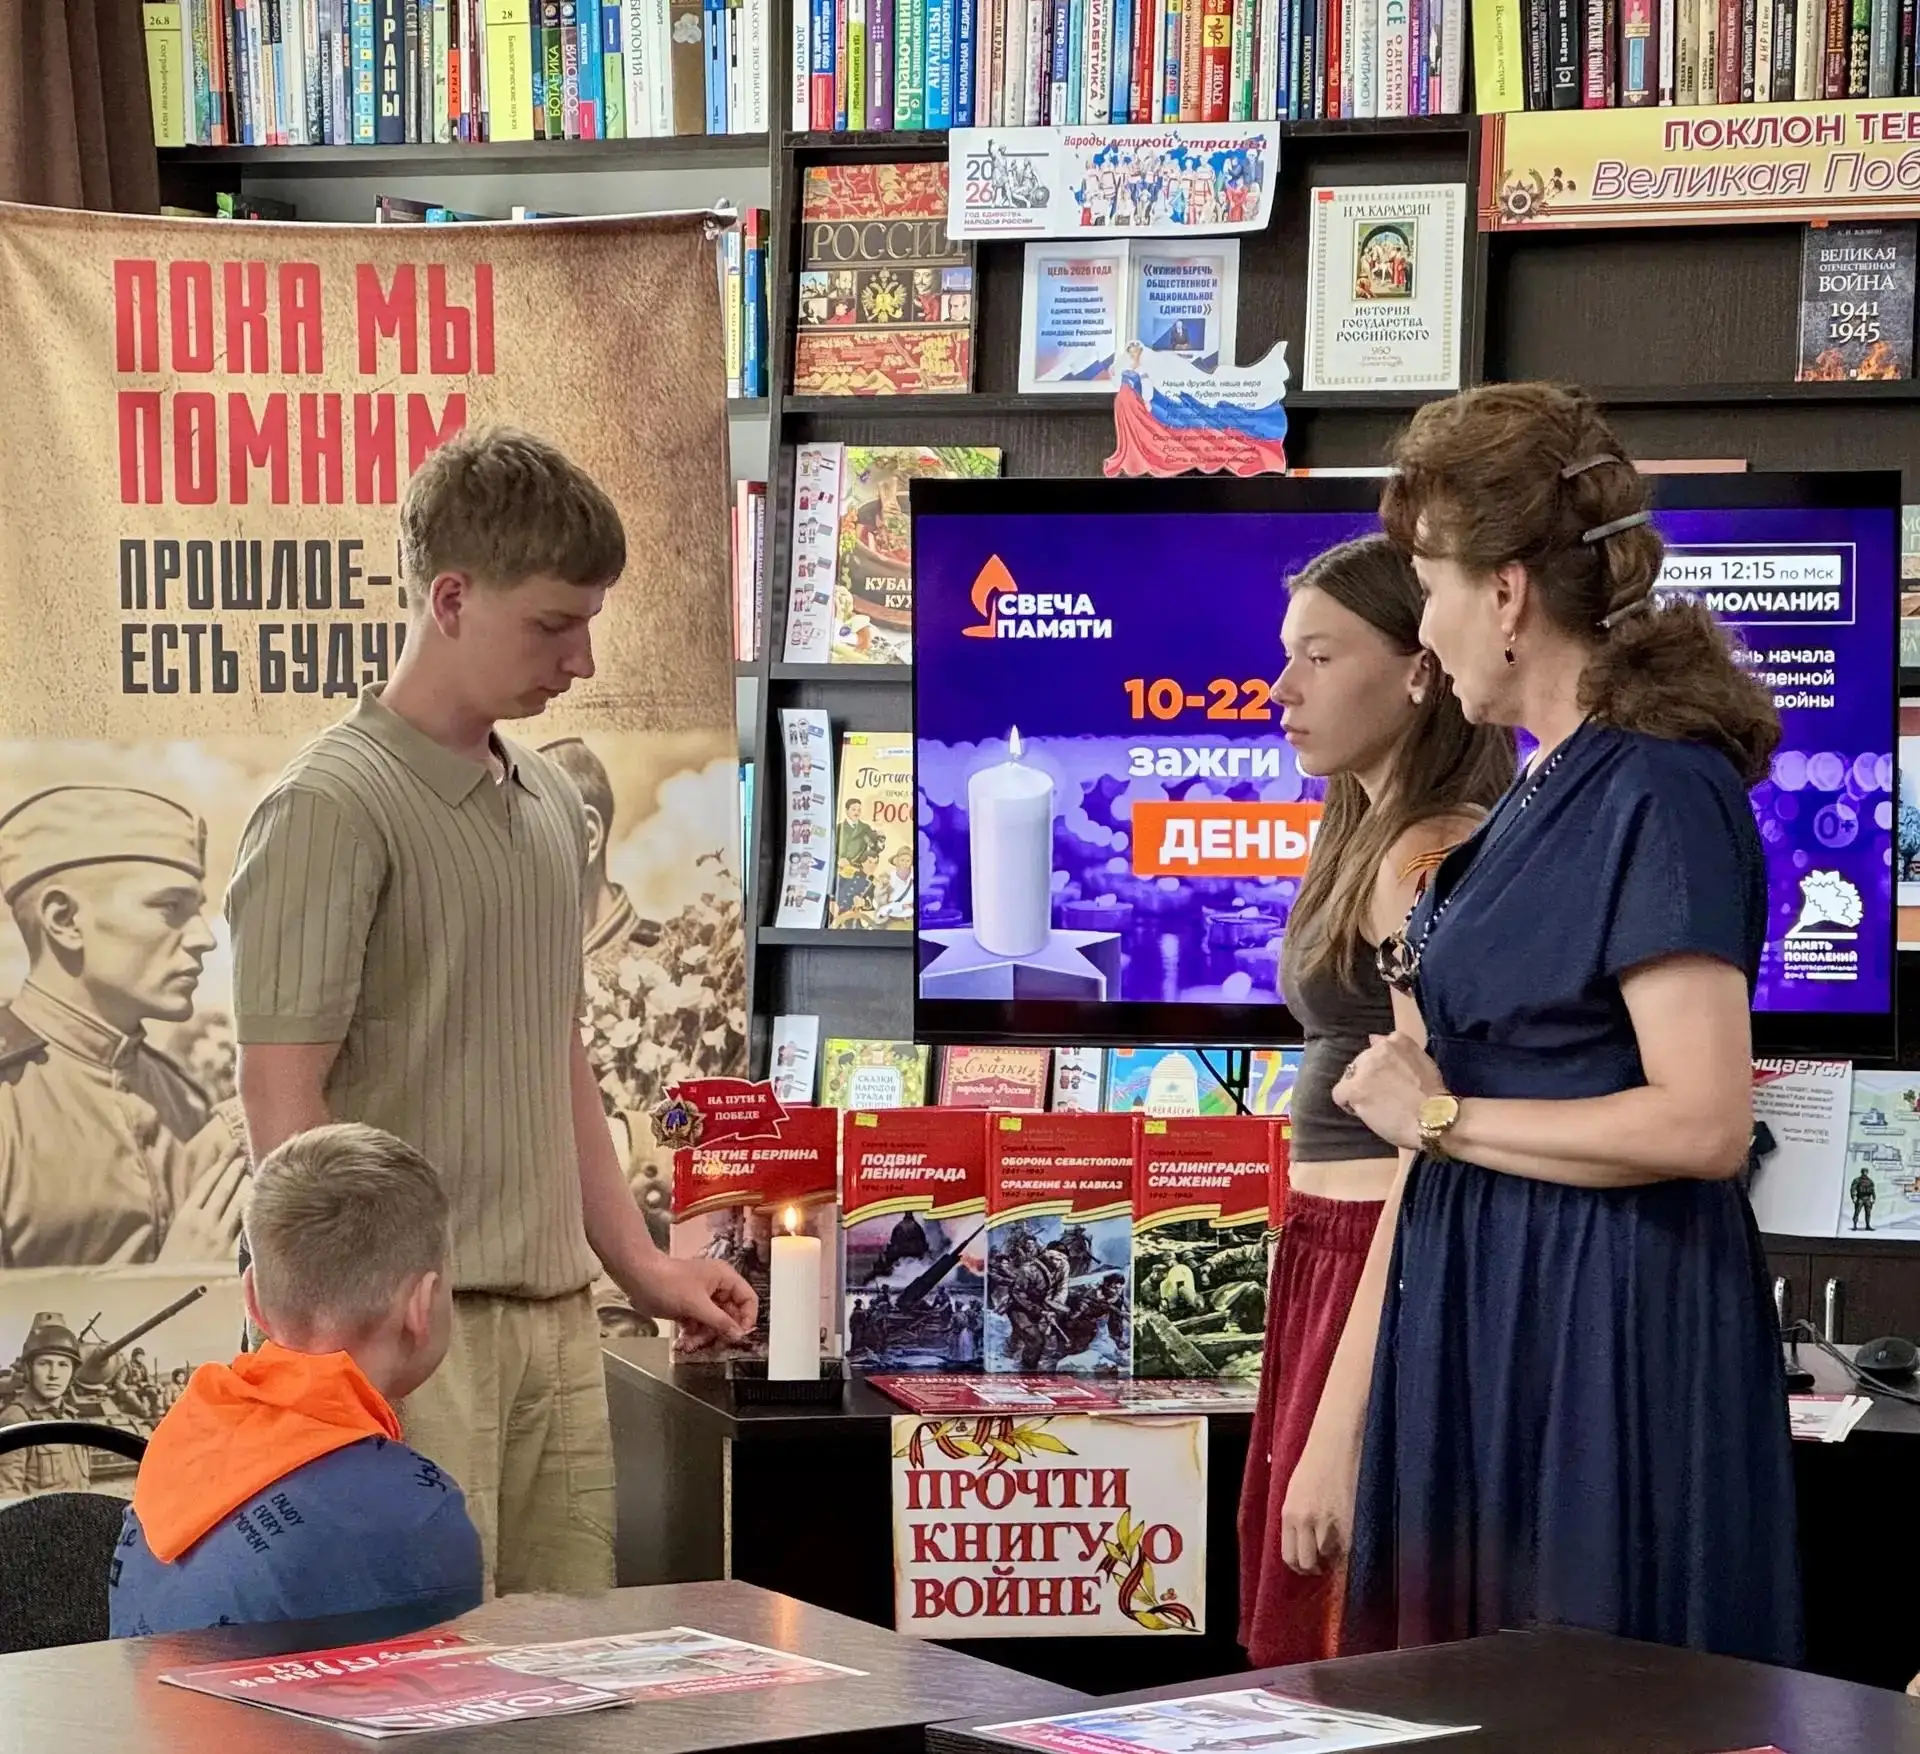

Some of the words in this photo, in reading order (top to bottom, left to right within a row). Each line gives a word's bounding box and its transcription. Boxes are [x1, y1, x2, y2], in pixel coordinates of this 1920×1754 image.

[150, 16, 170, 26] 26.8
[501, 10, 513, 19] 28
[796, 25, 805, 73] ДОКТОР
[928, 7, 940, 88] АНАЛИЗЫ
[1394, 34, 1403, 45] О
[1759, 38, 1768, 62] МИР
[320, 40, 329, 76] РОССИИ
[508, 36, 516, 102] Биологические
[1302, 35, 1312, 100] НАРКОЛОГИЯ
[159, 39, 170, 110] Географические
[548, 45, 561, 118] БОТАНИКА
[566, 44, 579, 116] ЗООЛОГИЯ
[959, 43, 969, 105] МАНУАЛЬНАЯ
[1213, 64, 1224, 106] КРОВИ
[1386, 40, 1394, 112] БОЛЕЗНЯХ
[1394, 48, 1403, 112] ДЕТСКИХ
[1496, 59, 1506, 96] история
[322, 80, 331, 116] РОДНОЙ
[796, 75, 805, 104] БАНЯ
[1063, 134, 1106, 149] Народы
[1180, 136, 1268, 151] страны
[1664, 114, 1843, 150] ПОКЛОН
[966, 159, 993, 181] 20
[1590, 158, 1809, 199] Великая
[965, 181, 993, 204] 26
[1368, 203, 1431, 217] КАРАМЗИН
[964, 218, 1001, 226] НАРОДОВ
[1002, 218, 1034, 226] РОССИИ
[1820, 247, 1897, 262] ВЕЛИКАЯ
[1047, 266, 1068, 276] ЦЕЛЬ
[1092, 265, 1112, 276] ГОДА
[1182, 263, 1213, 275] БЕРЕЧЬ
[1819, 262, 1896, 272] ОТЕЧЕСТВЕННАЯ
[1146, 278, 1211, 289] ОБЩЕСТВЕННОЕ
[1818, 273, 1896, 293] ВОЙНА
[1148, 291, 1214, 302] НАЦИОНАЛЬНОЕ
[113, 259, 324, 375] ПОКА
[355, 263, 496, 376] МЫ
[1354, 306, 1411, 316] ИСТОРИЯ
[1829, 301, 1880, 323] 1941
[1341, 317, 1424, 329] ГОСУДАРСТВА
[1829, 322, 1881, 344] 1945
[1336, 329, 1430, 342] РОССИЙСКОГО
[1658, 564, 1712, 580] юня
[1720, 560, 1776, 581] 12:15
[1780, 568, 1799, 580] по
[1803, 566, 1835, 580] Мск
[997, 592, 1096, 616] СВЕЧА
[1706, 592, 1841, 612] МОЛЧАНИЯ
[996, 617, 1113, 640] ПАМЯТИ
[120, 622, 240, 694] ЕСТЬ
[1768, 648, 1836, 665] начала
[1124, 677, 1272, 720] 10-22
[1773, 691, 1836, 709] войны
[1128, 746, 1281, 778] зажги
[1784, 940, 1834, 951] ПАМЯТЬ
[1784, 950, 1858, 962] ПОКОЛЕНИЙ
[855, 1085, 897, 1094] НАРОДОВ
[858, 1075, 894, 1084] СКАЗКИ
[707, 1094, 723, 1105] НА
[725, 1094, 756, 1105] ПУТИ
[758, 1094, 768, 1104] К
[714, 1110, 760, 1122] ПОБЕДЕ
[692, 1148, 748, 1161] ВЗЯТИЕ
[751, 1148, 820, 1162] БЕРЛИНА
[860, 1152, 928, 1168] ПОДВИГ
[1001, 1156, 1053, 1167] ОБОРОНА
[1054, 1156, 1134, 1167] СЕВАСТОПОЛЯ
[860, 1167, 967, 1183] ЛЕНИНГРАДА
[1000, 1180, 1062, 1190] СРАЖЕНИЕ
[1062, 1180, 1078, 1190] ЗА
[1079, 1180, 1124, 1191] КАВКАЗ
[1148, 1176, 1233, 1188] СРАЖЕНИЕ
[903, 1467, 1131, 1511] ПРОЧТИ
[250, 1503, 286, 1538] EVERY
[270, 1492, 306, 1527] ENJOY
[233, 1510, 271, 1554] MOMENT
[908, 1521, 1115, 1564] КНИГУ
[1141, 1523, 1184, 1565] О
[909, 1565, 1103, 1619] ВОЙНЕ
